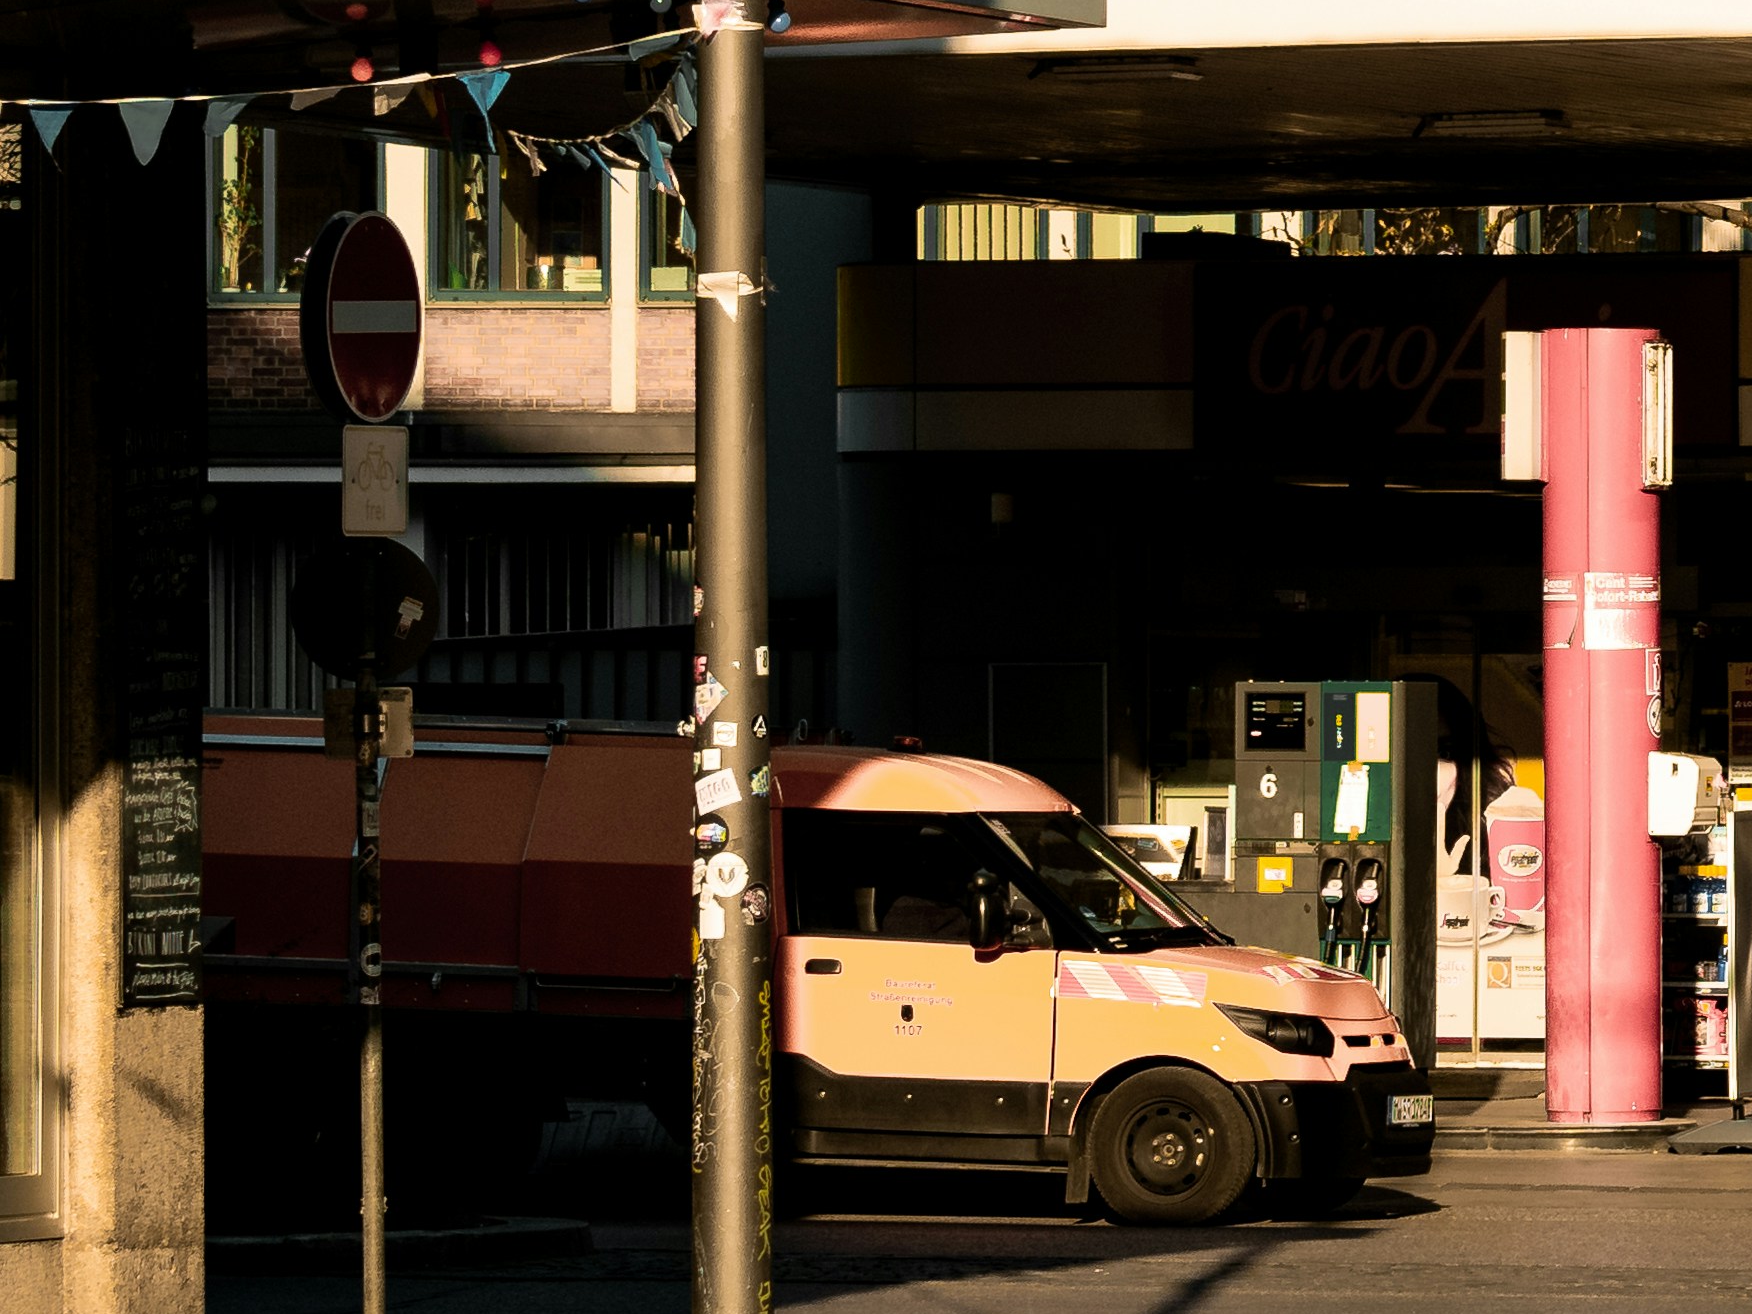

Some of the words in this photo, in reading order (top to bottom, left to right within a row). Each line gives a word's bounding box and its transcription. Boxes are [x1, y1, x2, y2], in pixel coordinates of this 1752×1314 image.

[366, 498, 386, 521] frei
[1259, 773, 1279, 799] 6
[895, 1025, 922, 1035] 1107
